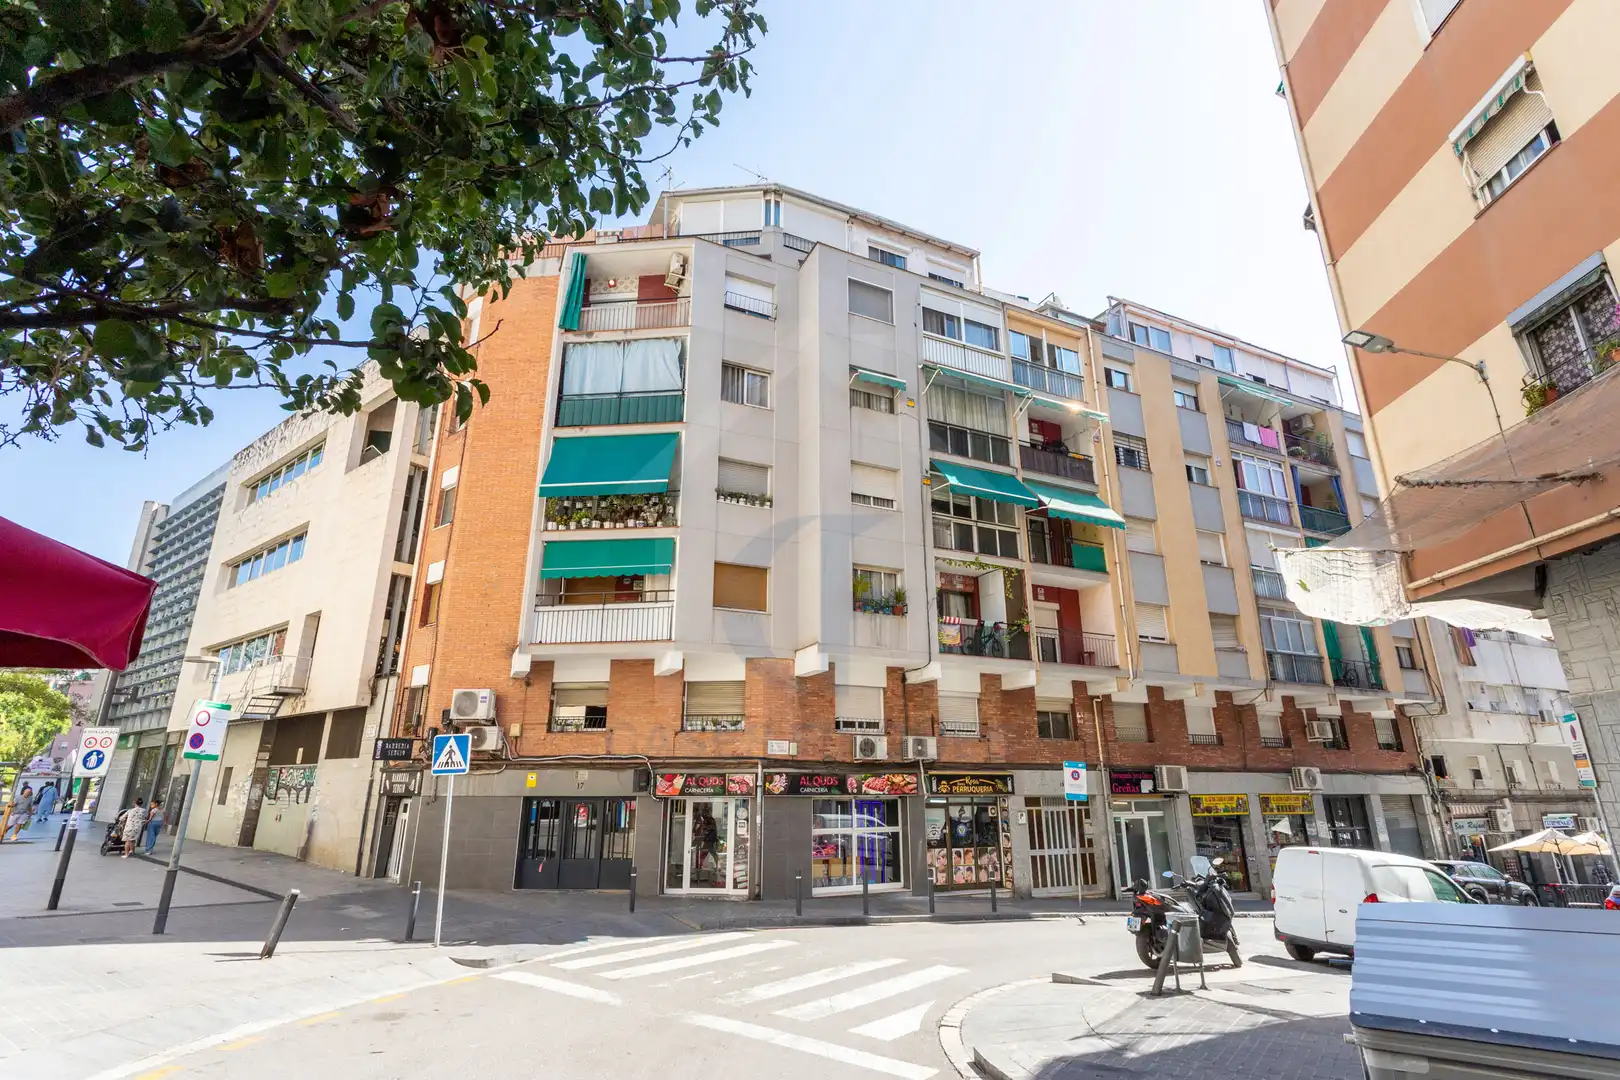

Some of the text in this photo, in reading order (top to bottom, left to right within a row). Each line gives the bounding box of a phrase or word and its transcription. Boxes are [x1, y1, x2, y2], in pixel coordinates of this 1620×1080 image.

[686, 776, 725, 787] AL QUDS
[799, 776, 839, 787] AL QUDS
[1112, 782, 1140, 793] Greñas
